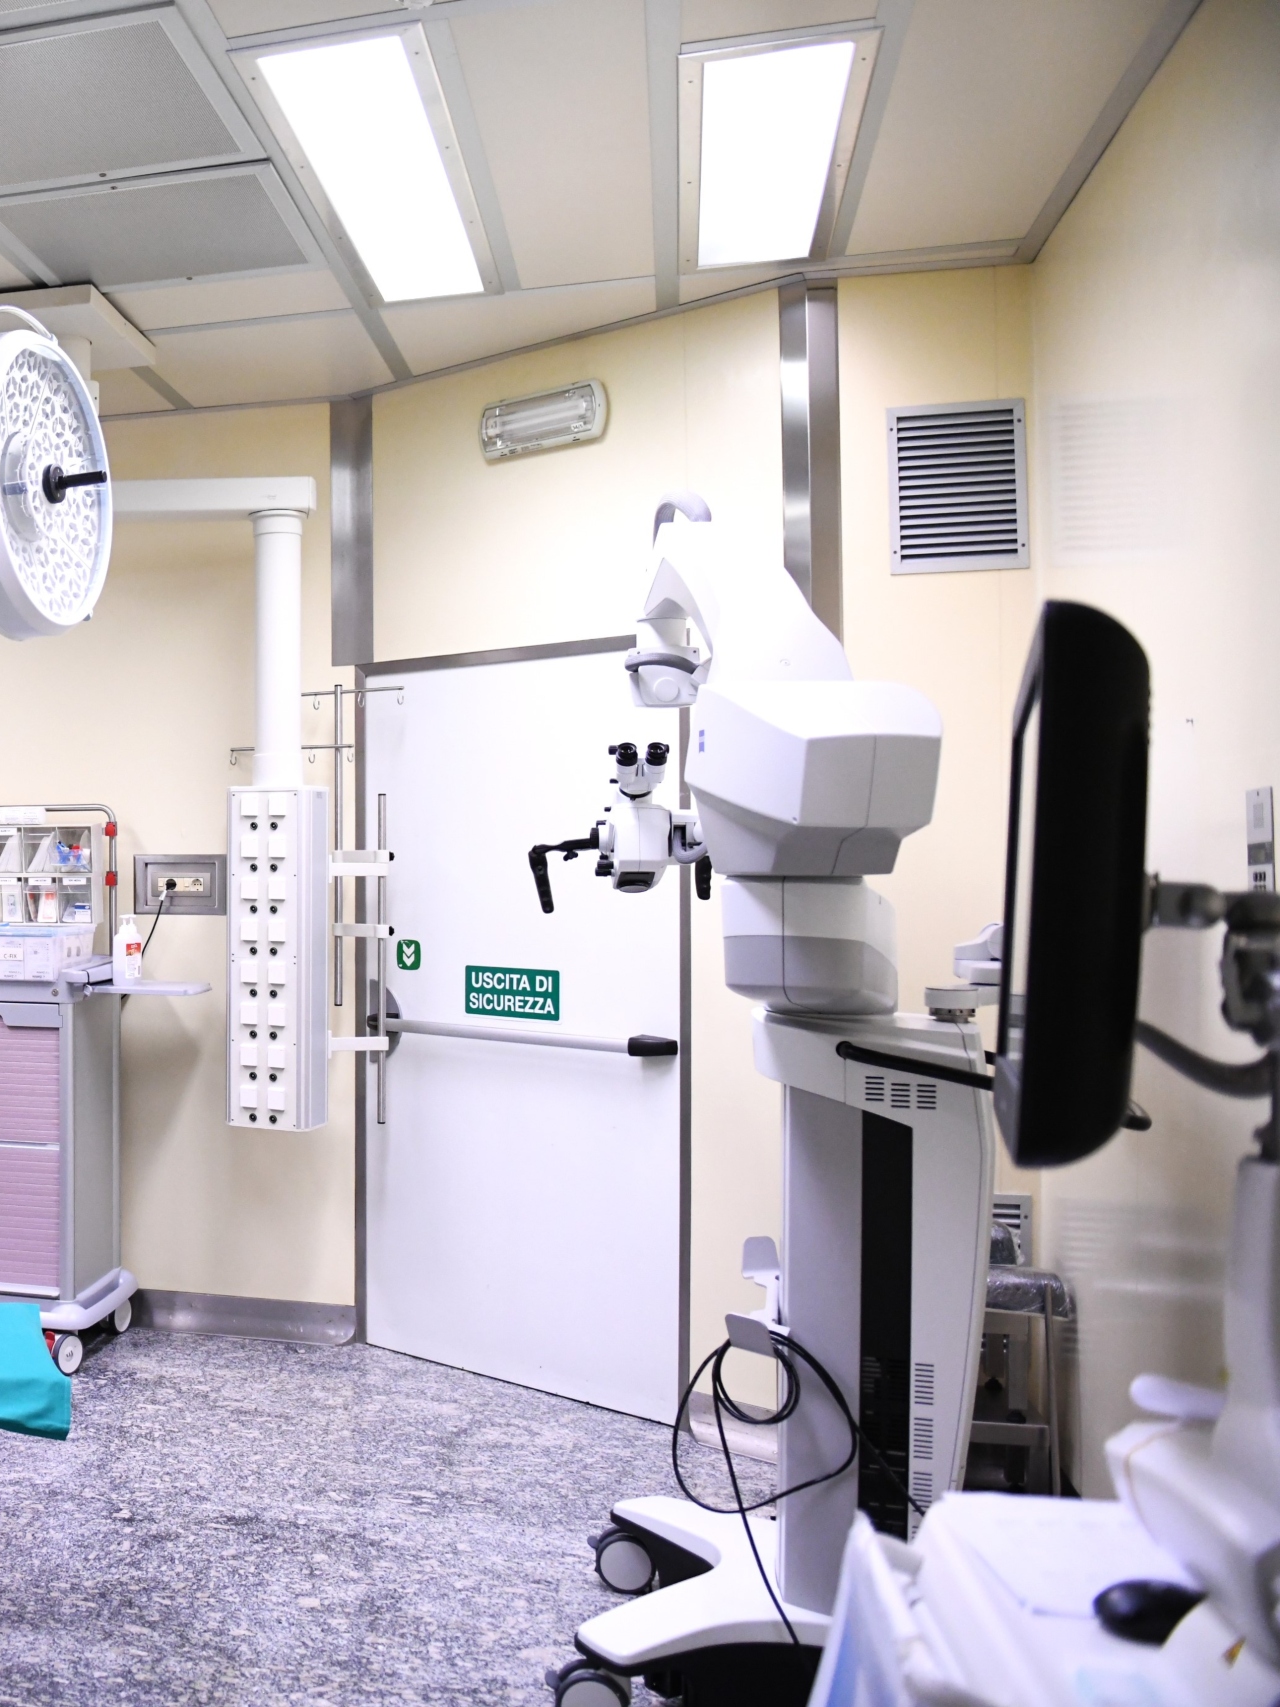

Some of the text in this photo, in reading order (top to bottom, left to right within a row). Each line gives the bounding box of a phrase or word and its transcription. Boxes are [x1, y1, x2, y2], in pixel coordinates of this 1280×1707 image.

[471, 971, 553, 993] USCITA DI
[469, 992, 555, 1015] SICUREZZA
